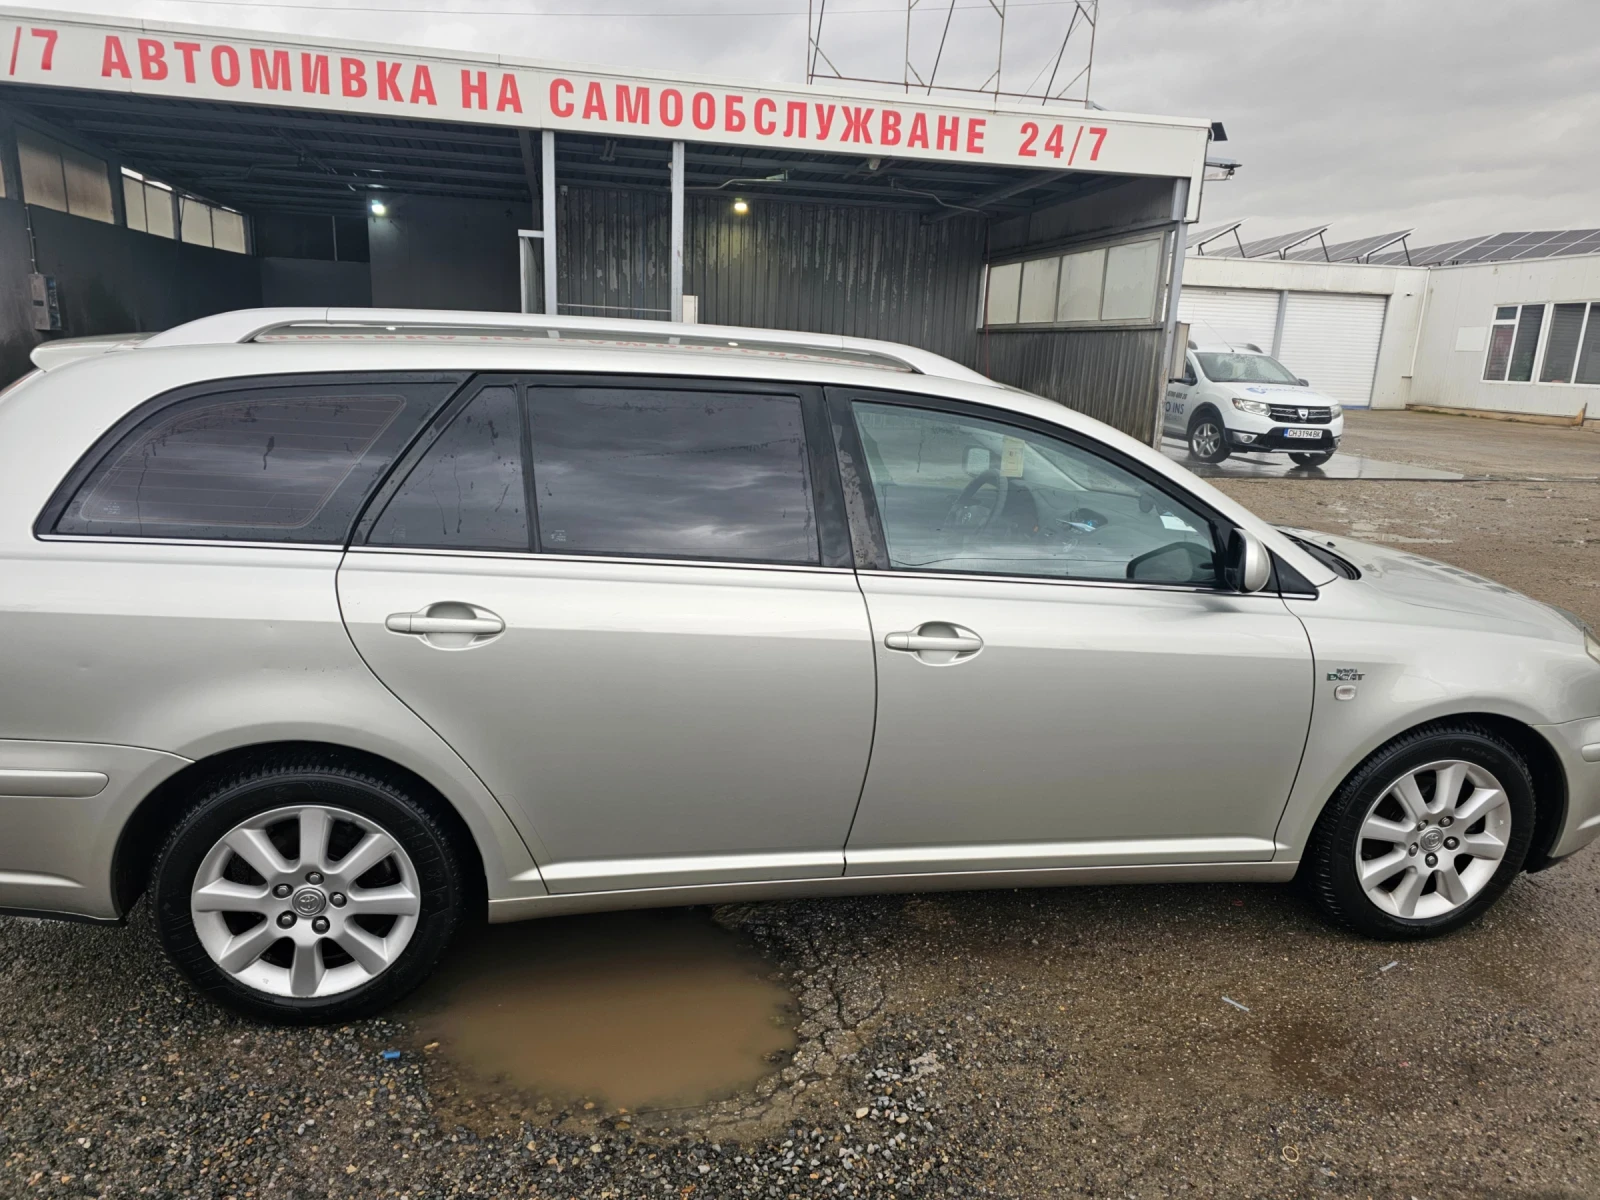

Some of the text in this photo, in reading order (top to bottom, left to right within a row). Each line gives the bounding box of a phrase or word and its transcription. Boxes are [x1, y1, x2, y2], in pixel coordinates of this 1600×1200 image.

[100, 35, 438, 106] АВТОМИВКА
[460, 69, 523, 114] НА
[549, 77, 987, 155] САМООБСЛУЖВАНЕ
[1017, 121, 1108, 166] 24/7
[1172, 402, 1185, 415] INS
